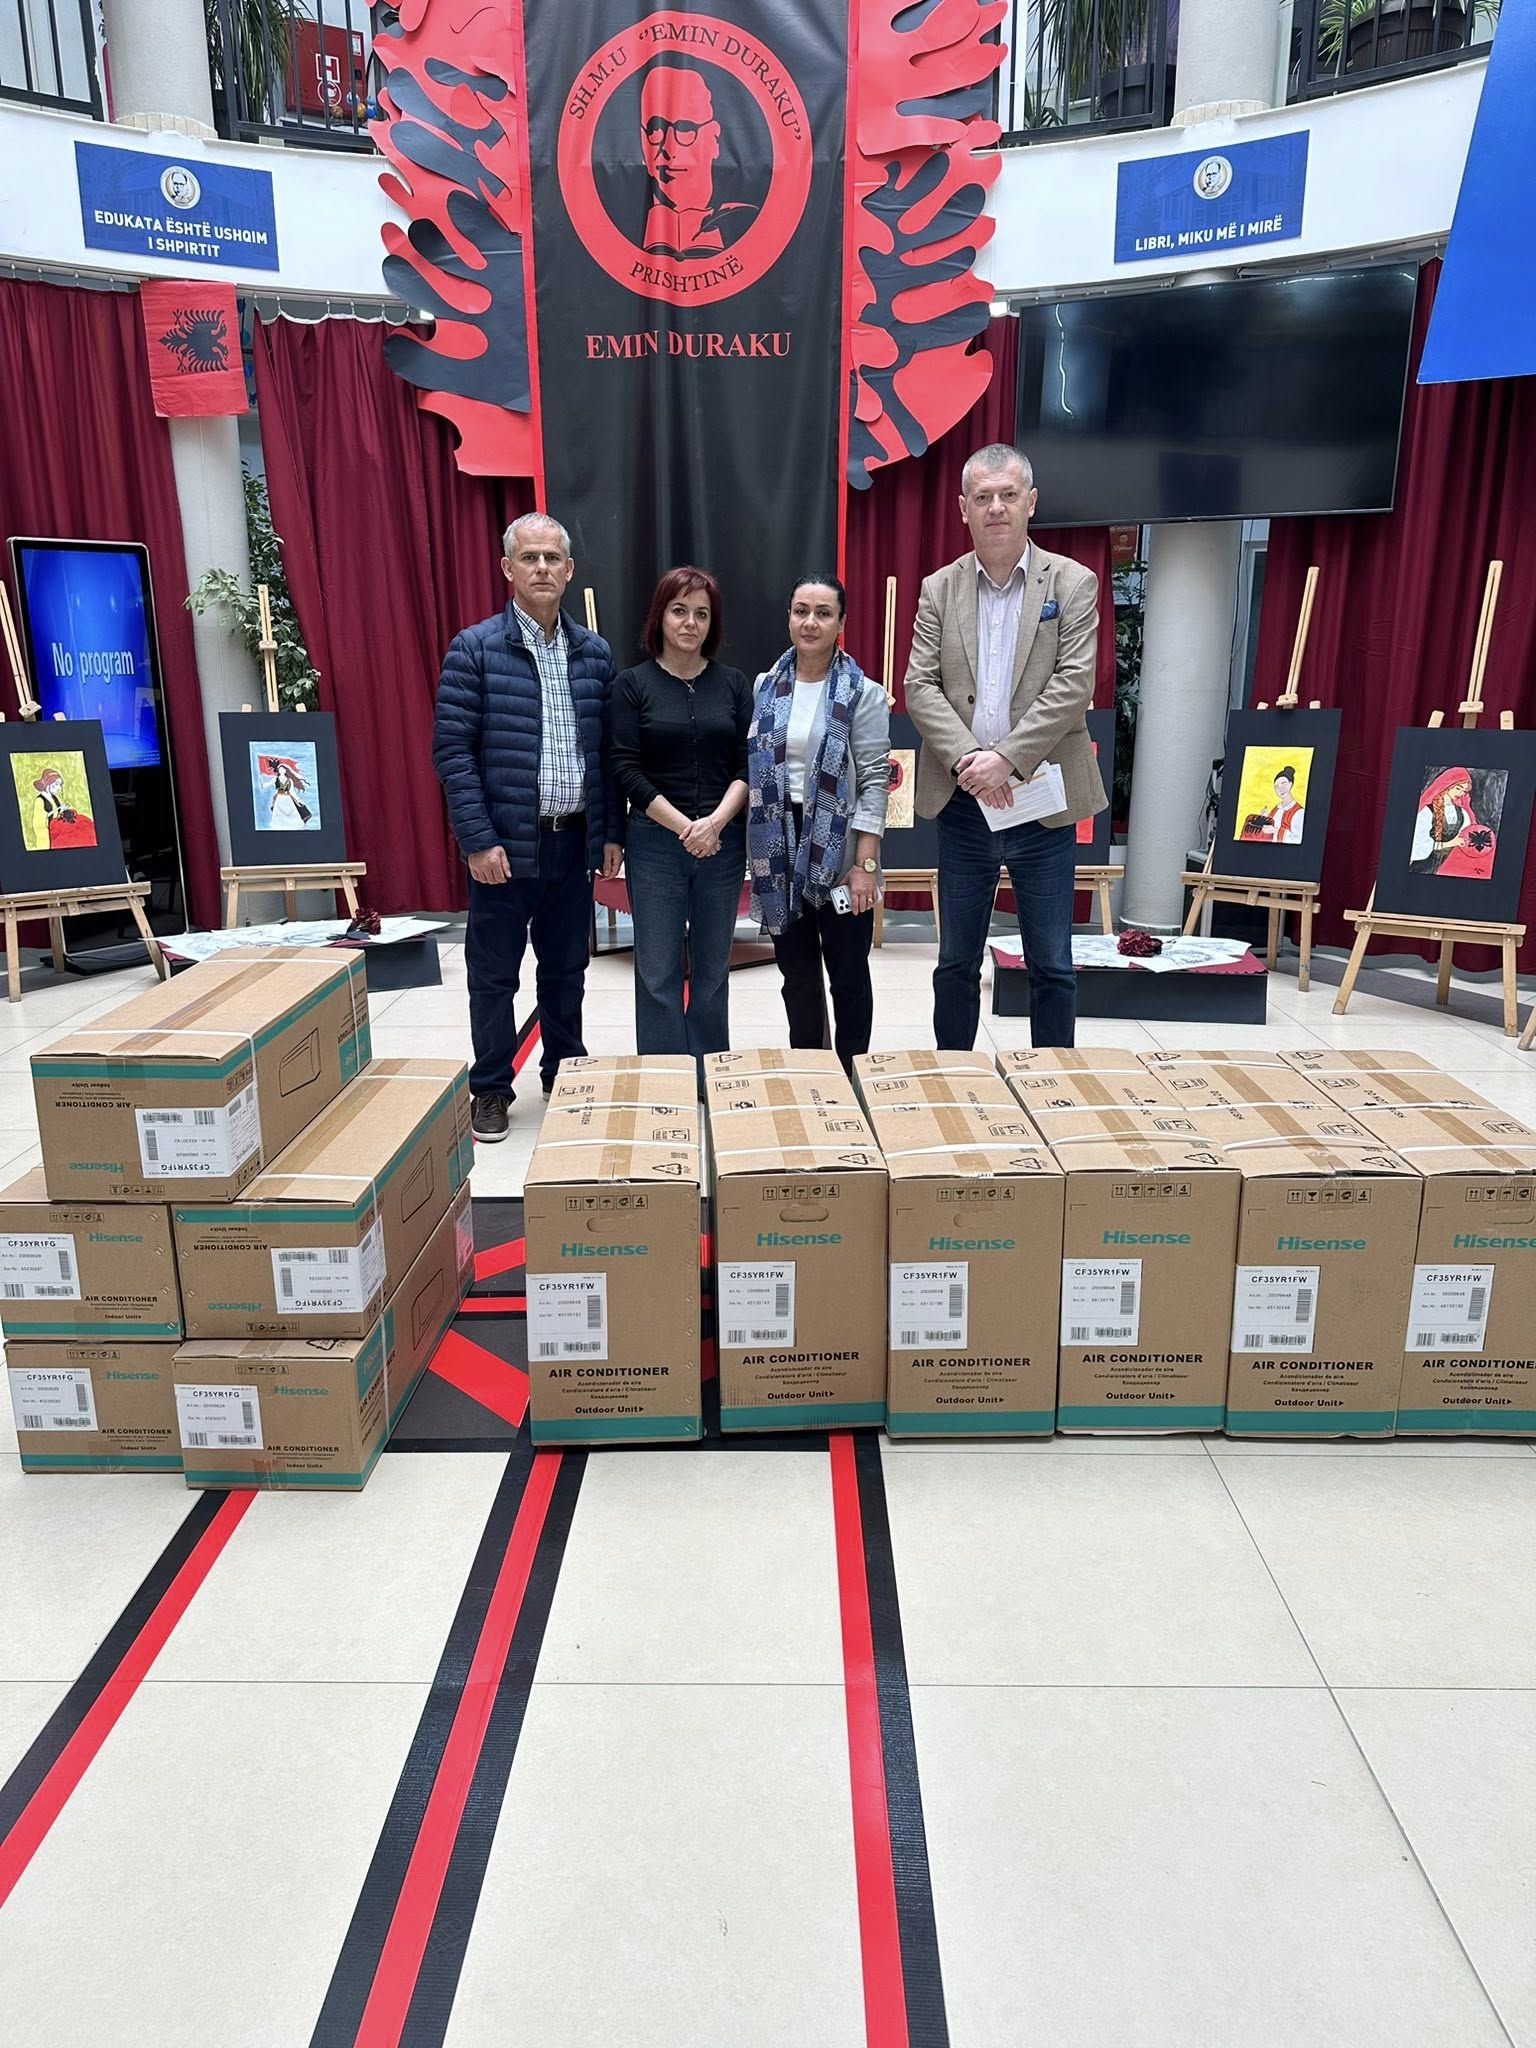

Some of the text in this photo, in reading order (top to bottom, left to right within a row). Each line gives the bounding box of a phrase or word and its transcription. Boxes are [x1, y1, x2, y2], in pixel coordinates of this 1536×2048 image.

[94, 209, 268, 245] EDUKATA ËSHTË USHQIM
[1135, 213, 1283, 252] LIBRI, MIKU MË I MIRË
[148, 236, 220, 258] I SHPIRTIT
[629, 254, 744, 292] PRISHTINË
[585, 330, 792, 359] EMIN DURAKU
[52, 642, 135, 684] No program
[69, 1162, 124, 1173] Hisense
[88, 1232, 144, 1242] Hisense
[756, 1232, 842, 1246] Hisense
[1102, 1231, 1192, 1244] Hisense
[928, 1236, 1016, 1250] Hisense
[1276, 1236, 1367, 1250] Hisense
[560, 1243, 648, 1257] Hisense
[730, 1271, 784, 1279] CF35YR1FW
[903, 1272, 958, 1280] CF35YR1FW
[539, 1282, 594, 1291] CF35YR1FW
[208, 1302, 262, 1312] Hisense
[743, 1352, 860, 1364] AIR CONDITIONER
[912, 1358, 1031, 1368] AIR CONDITIONER
[1082, 1354, 1203, 1363] AIR CONDITIONER
[1252, 1361, 1374, 1370] AIR CONDITIONER
[1422, 1360, 1536, 1370] AIR CONDITIONE
[106, 1370, 160, 1380] Hisense
[549, 1367, 669, 1378] AIR CONDITIONER
[273, 1386, 329, 1396] Hisense
[768, 1392, 806, 1400] Outdoor
[575, 1406, 614, 1414] Outdoor
